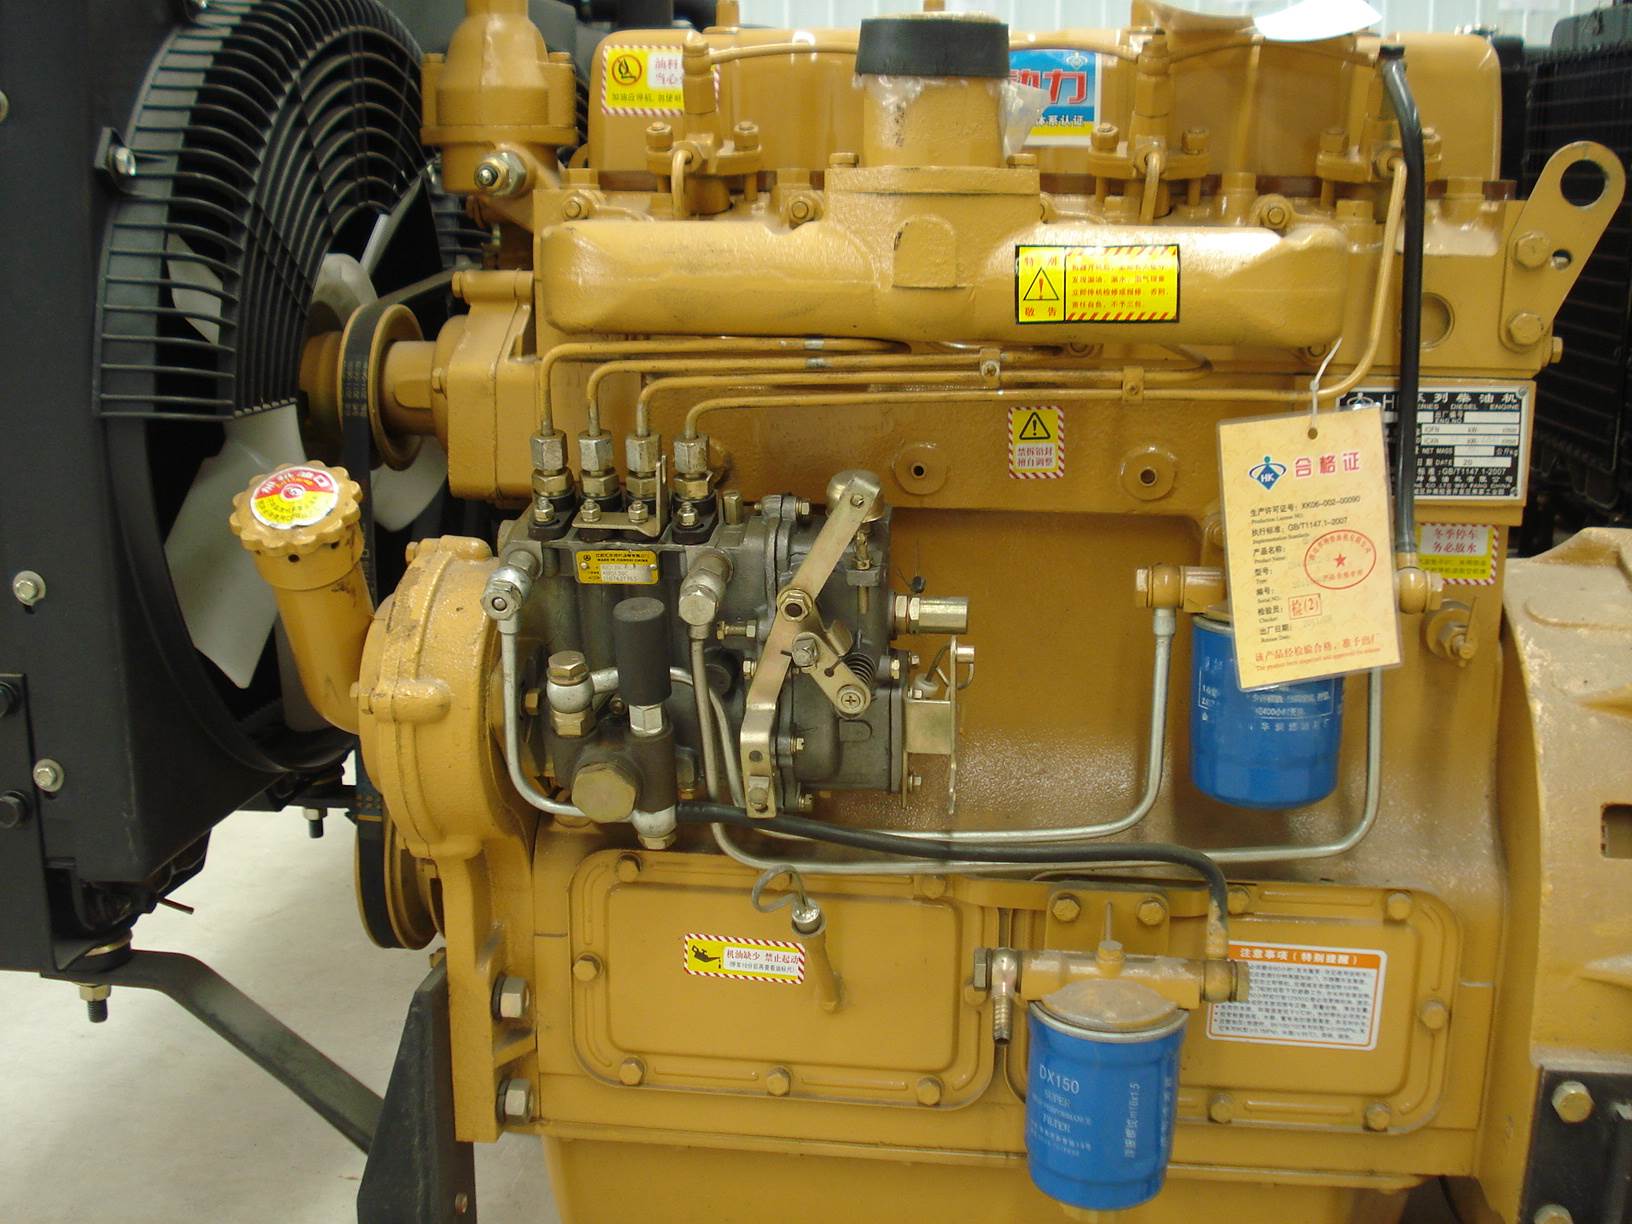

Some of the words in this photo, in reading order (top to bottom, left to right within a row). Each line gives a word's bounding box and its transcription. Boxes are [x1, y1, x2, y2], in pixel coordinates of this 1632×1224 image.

[1295, 451, 1360, 477] 合格证
[1039, 1064, 1080, 1094] DX150
